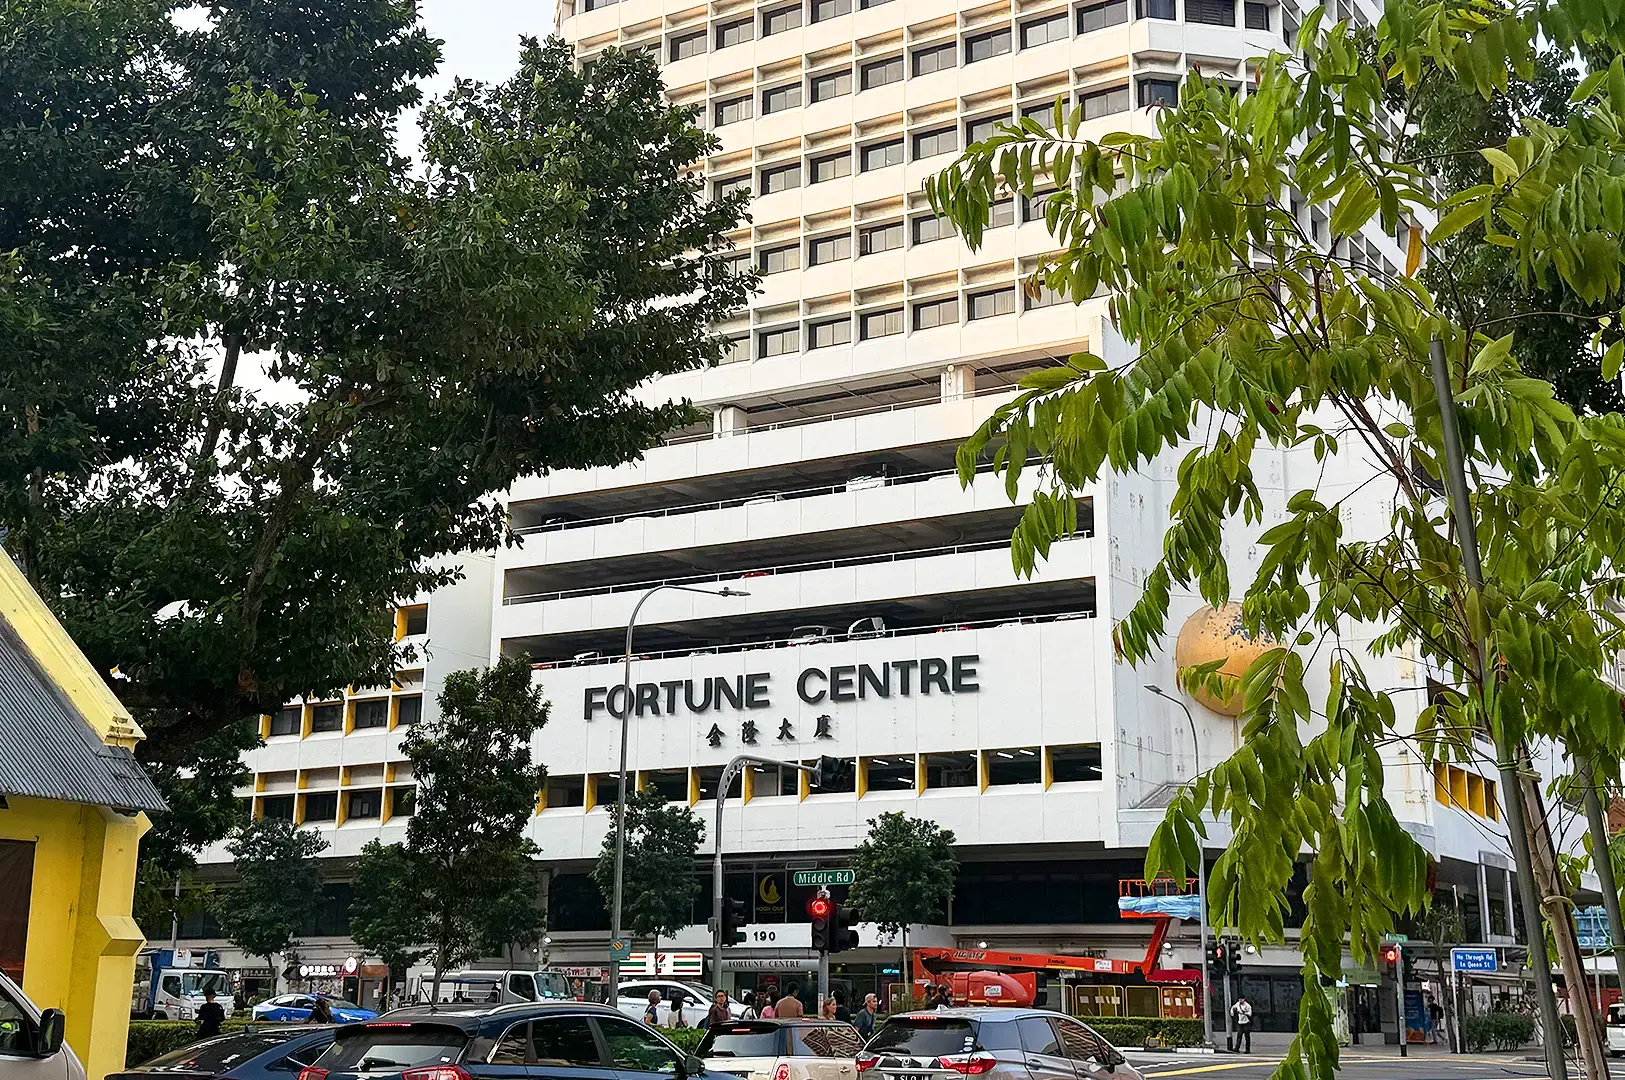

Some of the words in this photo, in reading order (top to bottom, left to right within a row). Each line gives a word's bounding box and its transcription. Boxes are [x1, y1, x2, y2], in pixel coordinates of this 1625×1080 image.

[584, 672, 770, 721] FORTUNE
[797, 654, 980, 703] CENTRE
[798, 873, 832, 884] Middle
[836, 872, 849, 882] Rd
[753, 931, 776, 941] 190
[728, 960, 764, 968] FORTUNE
[768, 959, 801, 968] CENTRE
